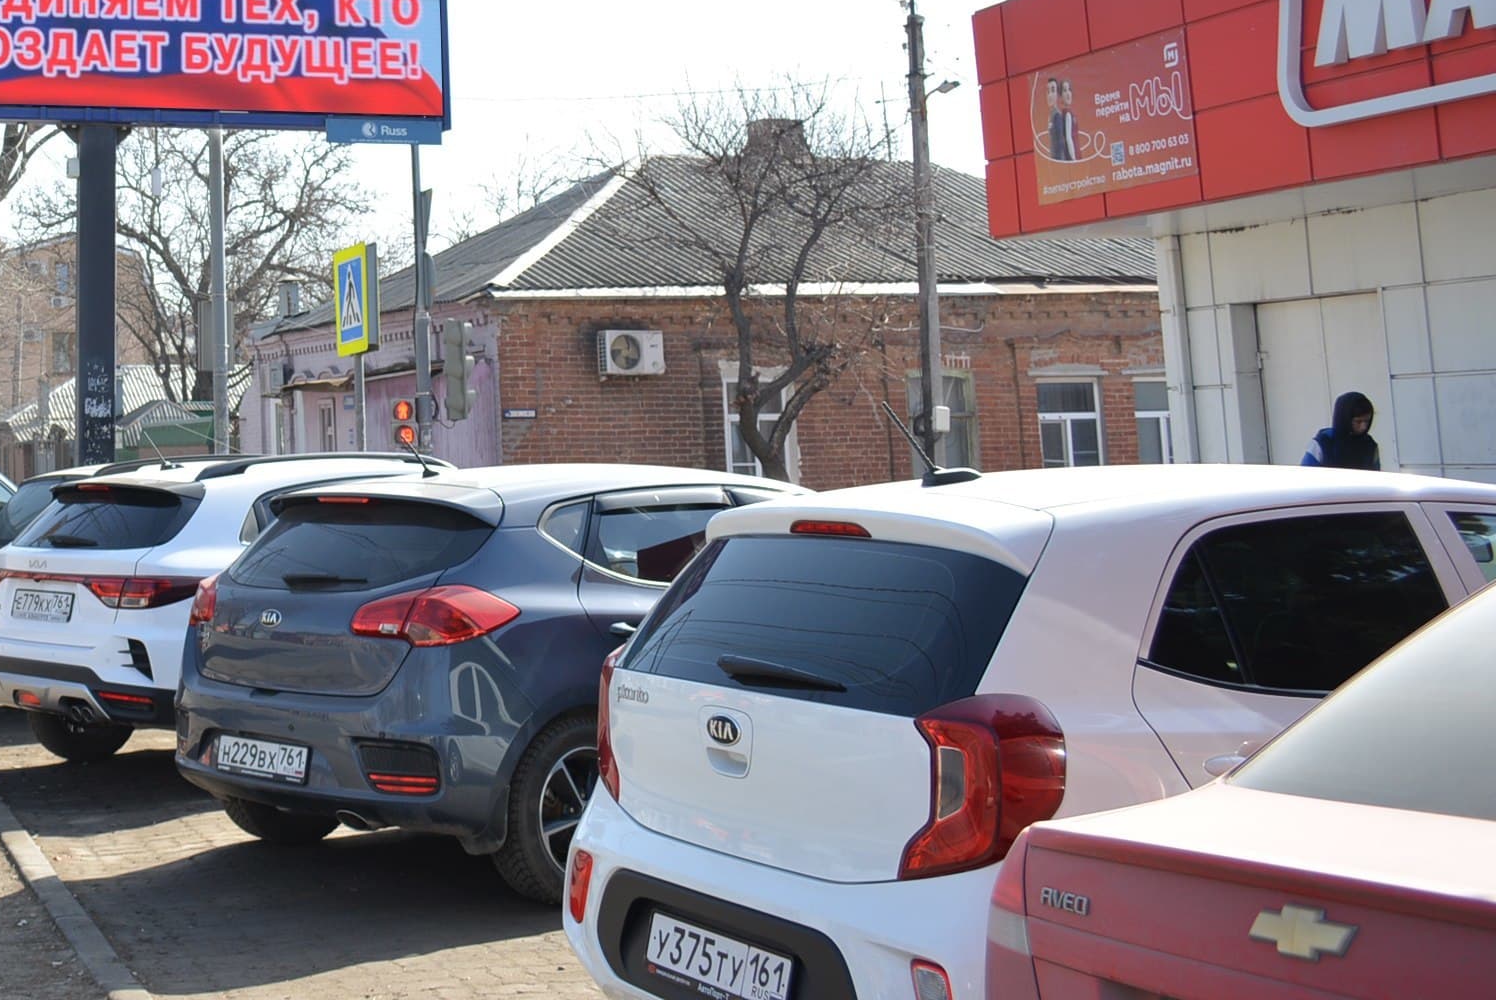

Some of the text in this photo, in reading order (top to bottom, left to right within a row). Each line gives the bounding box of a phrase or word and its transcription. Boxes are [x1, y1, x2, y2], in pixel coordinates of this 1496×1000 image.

[184, 33, 422, 83] БУДУЩЕЕ!
[1094, 90, 1121, 107] Время
[1095, 101, 1130, 118] перейти
[1119, 112, 1132, 124] на
[380, 125, 409, 137] Russ
[1151, 138, 1167, 151] 700
[1111, 155, 1193, 183] rabota.magnit.ru
[261, 611, 277, 624] KIA
[617, 684, 649, 704] picanto
[709, 719, 734, 740] KIA
[280, 747, 303, 769] 761
[1040, 886, 1090, 916] AVEO
[749, 952, 785, 993] 161
[751, 985, 770, 1000] RUS
